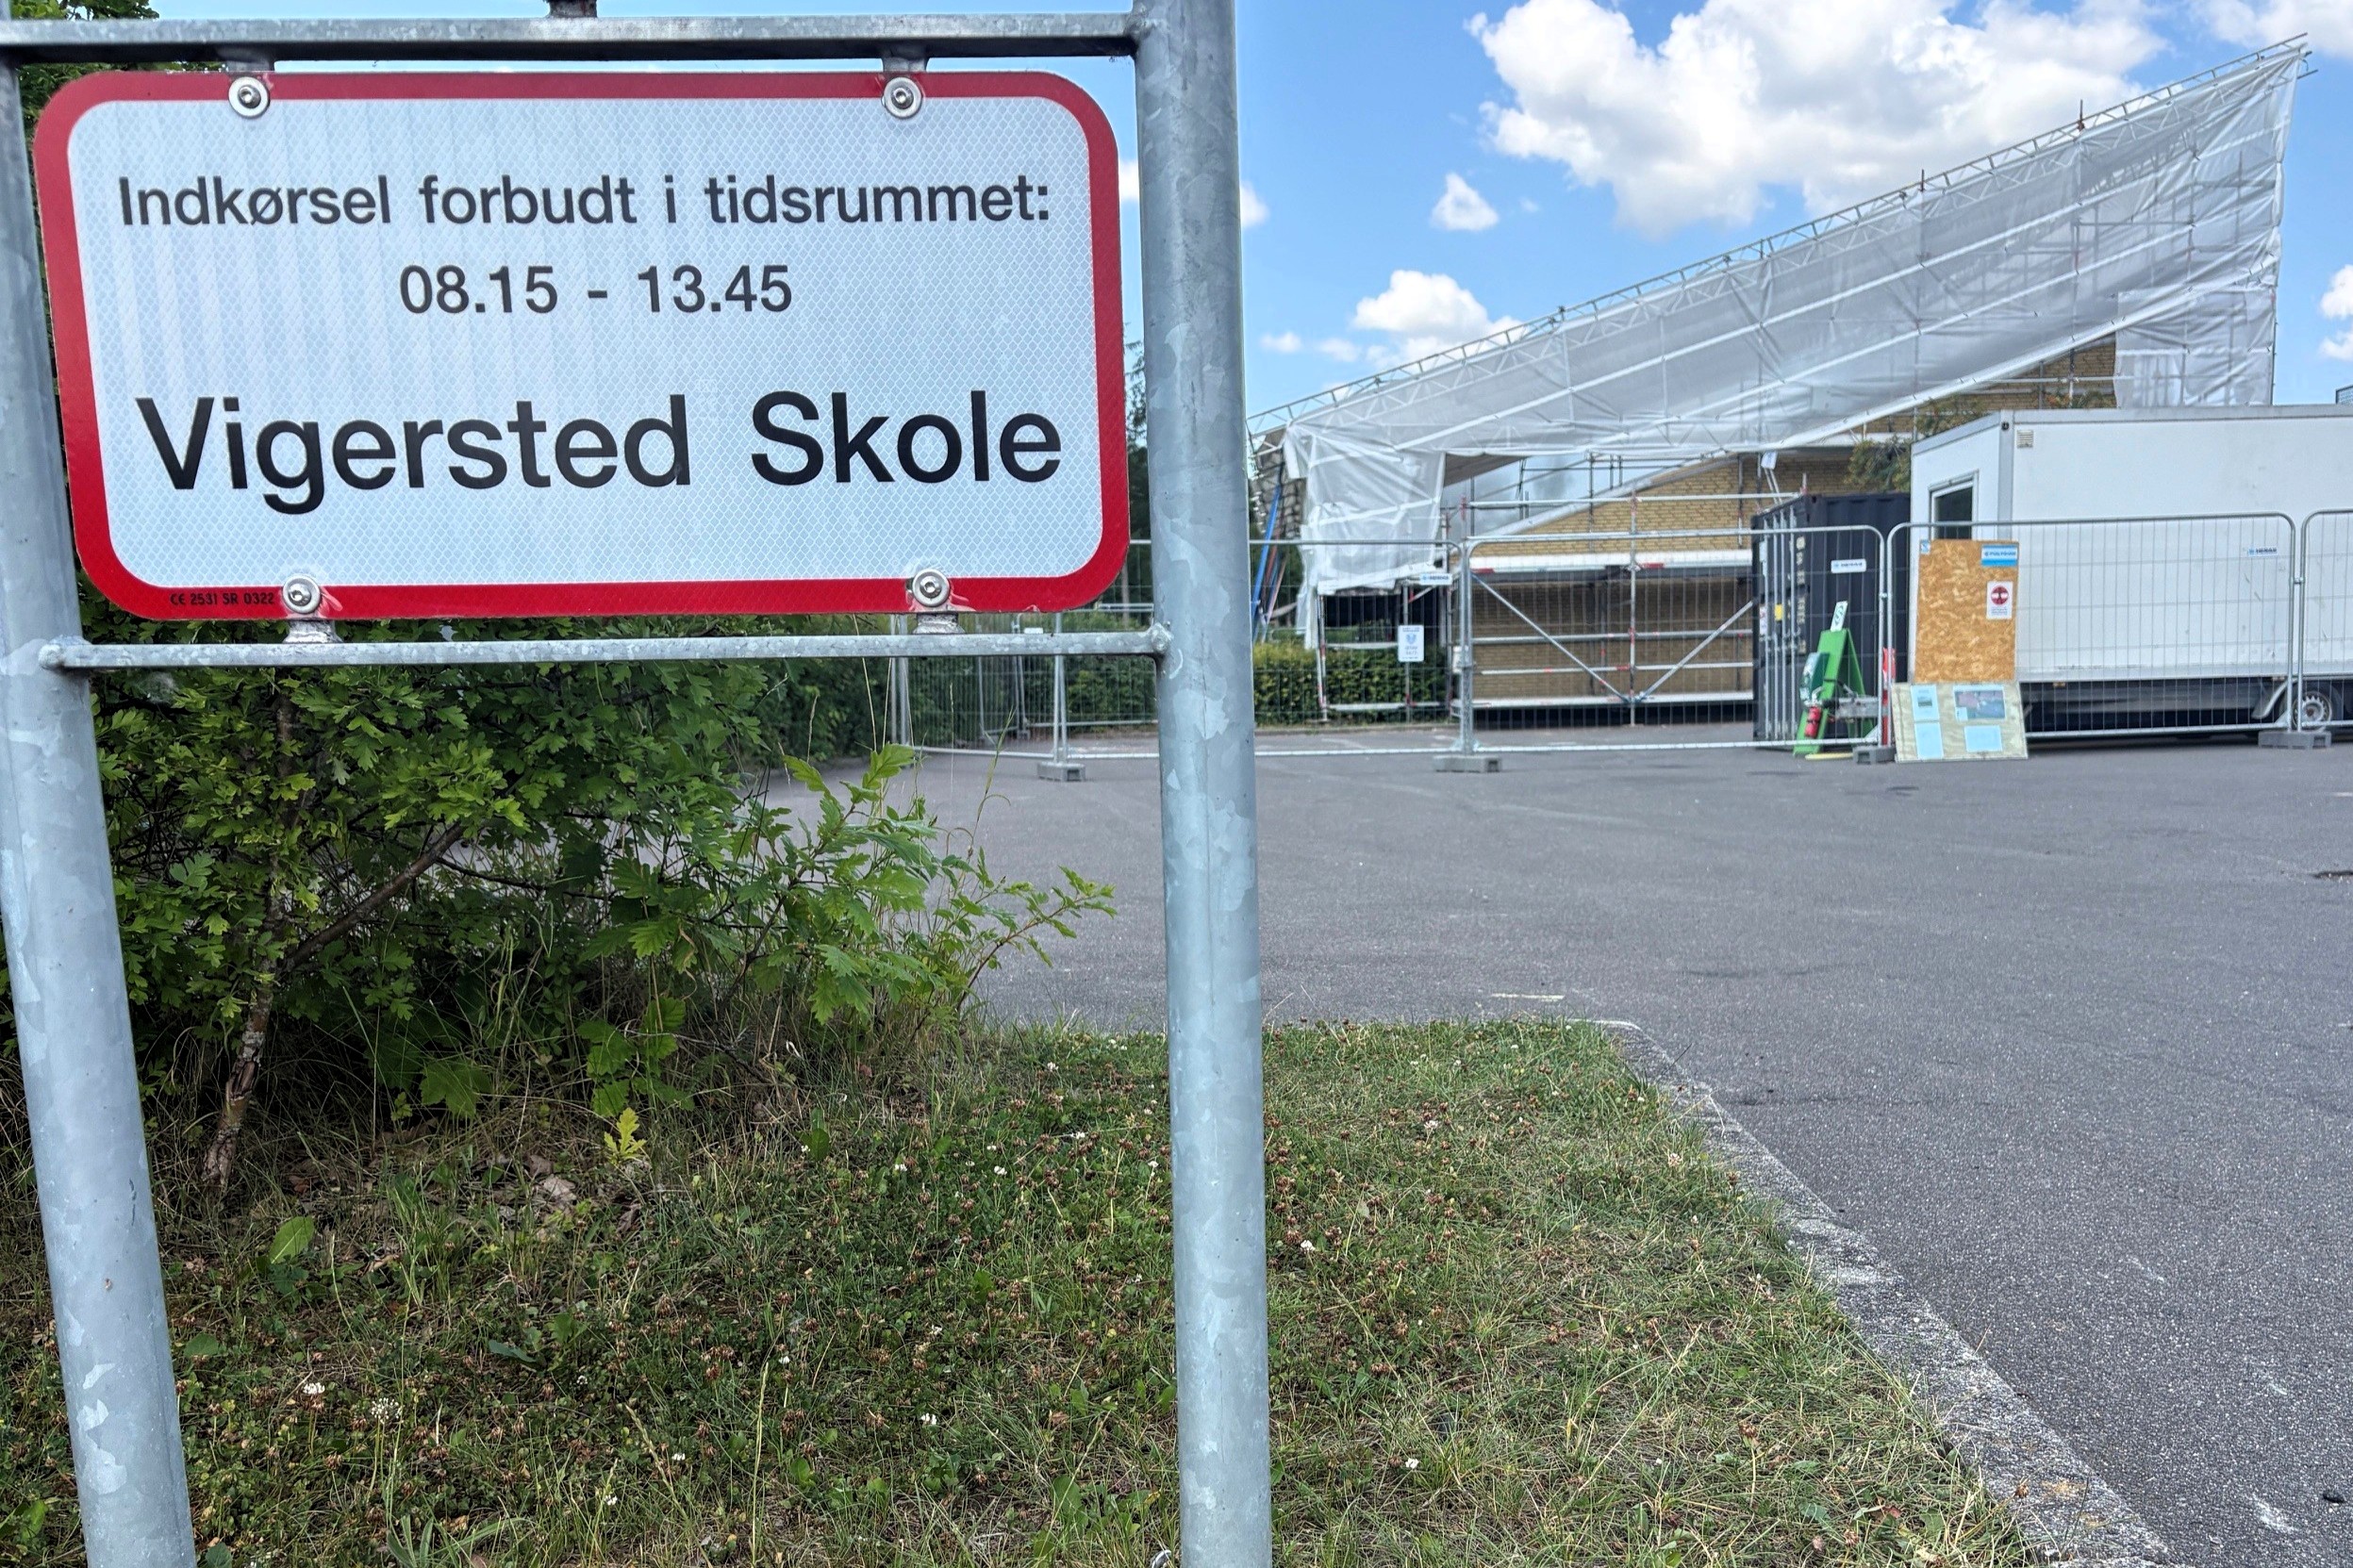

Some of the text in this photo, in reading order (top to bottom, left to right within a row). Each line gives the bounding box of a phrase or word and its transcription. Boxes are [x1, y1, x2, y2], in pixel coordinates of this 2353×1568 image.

[119, 174, 1049, 225] Indkørsel forbudt i tidsrummet:
[400, 264, 792, 314] 08.15 - 13.45
[136, 389, 1062, 516] Vigersted Skole
[190, 592, 217, 605] 2531
[243, 592, 274, 604] 0322
